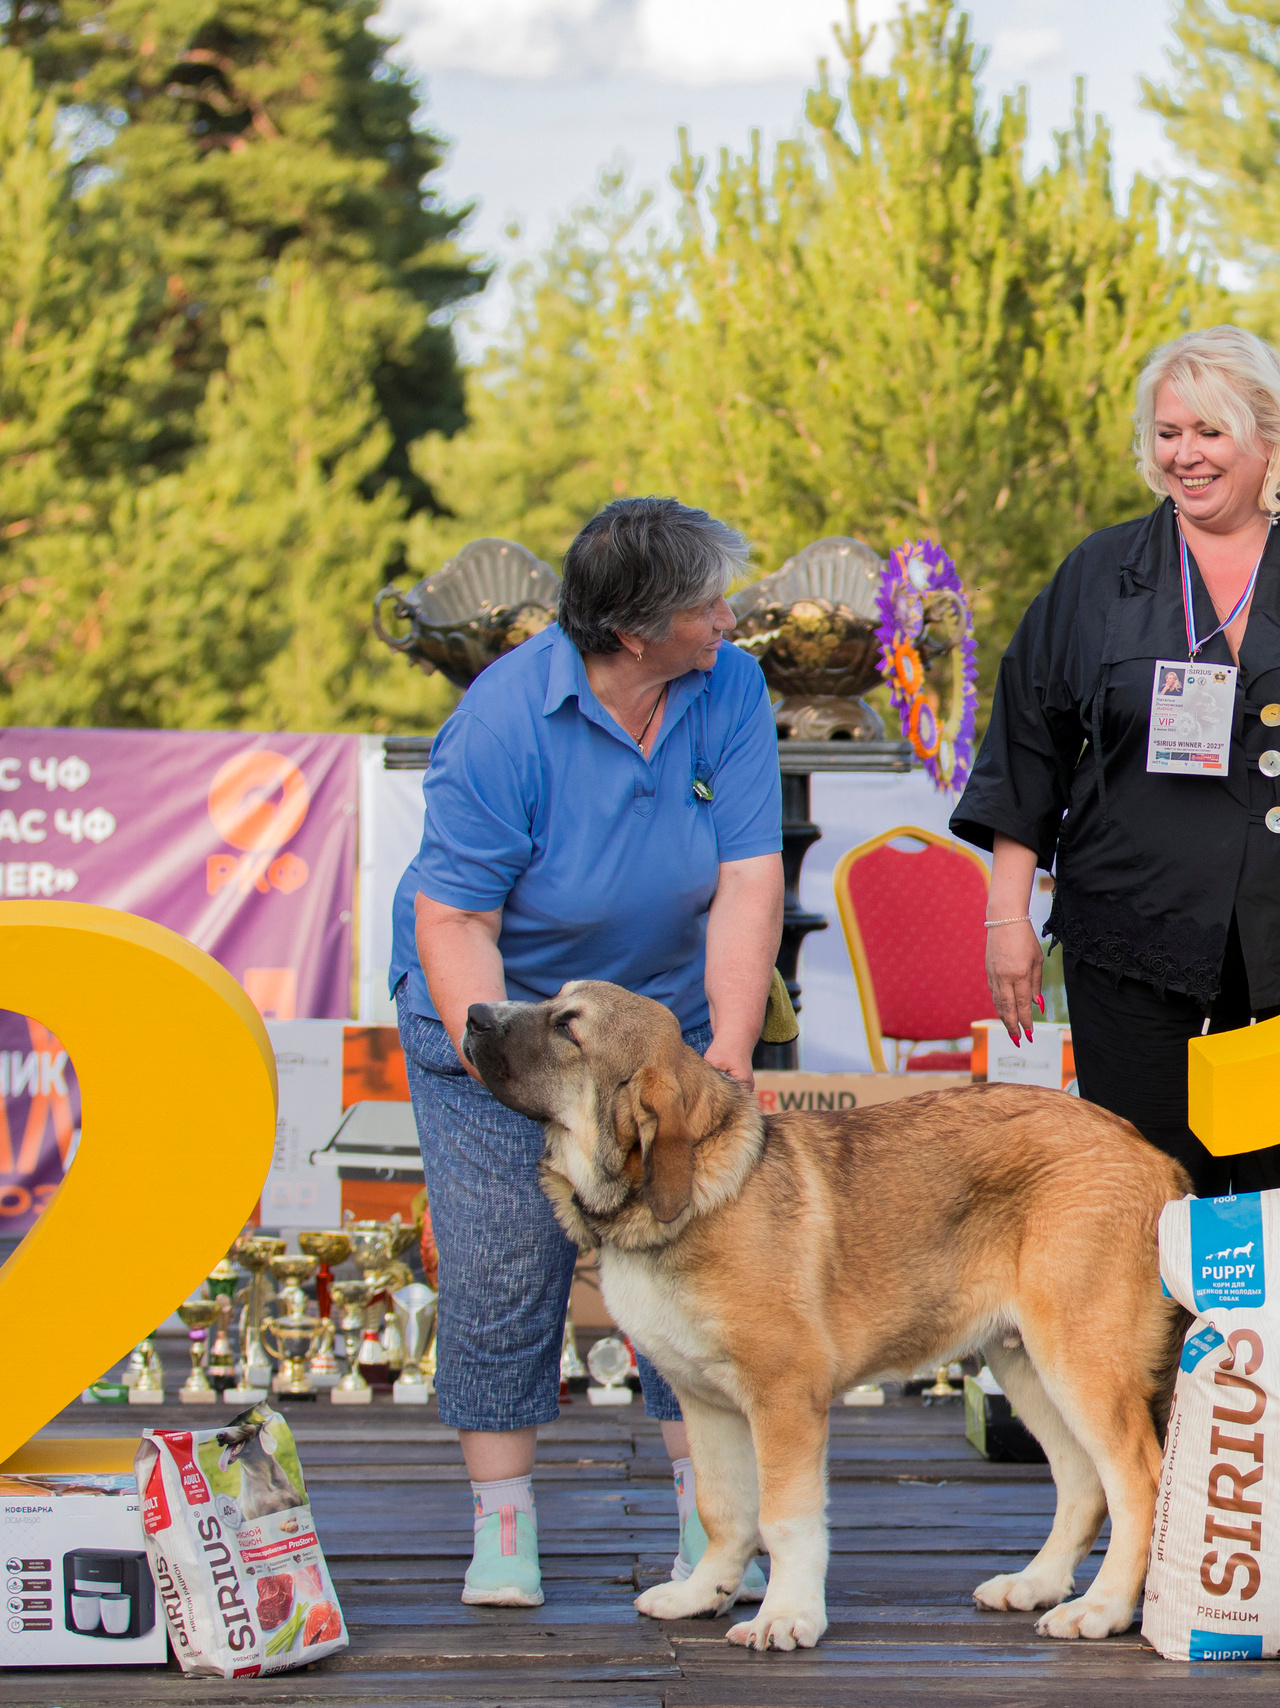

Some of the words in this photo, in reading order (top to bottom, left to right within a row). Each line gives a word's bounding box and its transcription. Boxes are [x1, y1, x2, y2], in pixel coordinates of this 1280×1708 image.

[29, 755, 91, 792] ЧФ
[54, 806, 117, 844] ЧФ
[1213, 1195, 1237, 1205] FOOD
[1202, 1264, 1256, 1279] PUPPY
[1196, 1288, 1223, 1296] ЩЕНКОВ
[1168, 1414, 1182, 1471] РИСОМ
[1200, 1328, 1266, 1601] SIRIUS
[184, 1473, 200, 1486] ADULT
[1166, 1476, 1172, 1486] С
[1158, 1490, 1171, 1562] ЯГНЕНОК
[288, 1537, 314, 1549] ProStor+
[198, 1515, 256, 1652] SIRIUS
[1197, 1606, 1259, 1623] PREMIUM
[232, 1653, 260, 1663] PREMIUM
[1204, 1650, 1250, 1660] PUPPY
